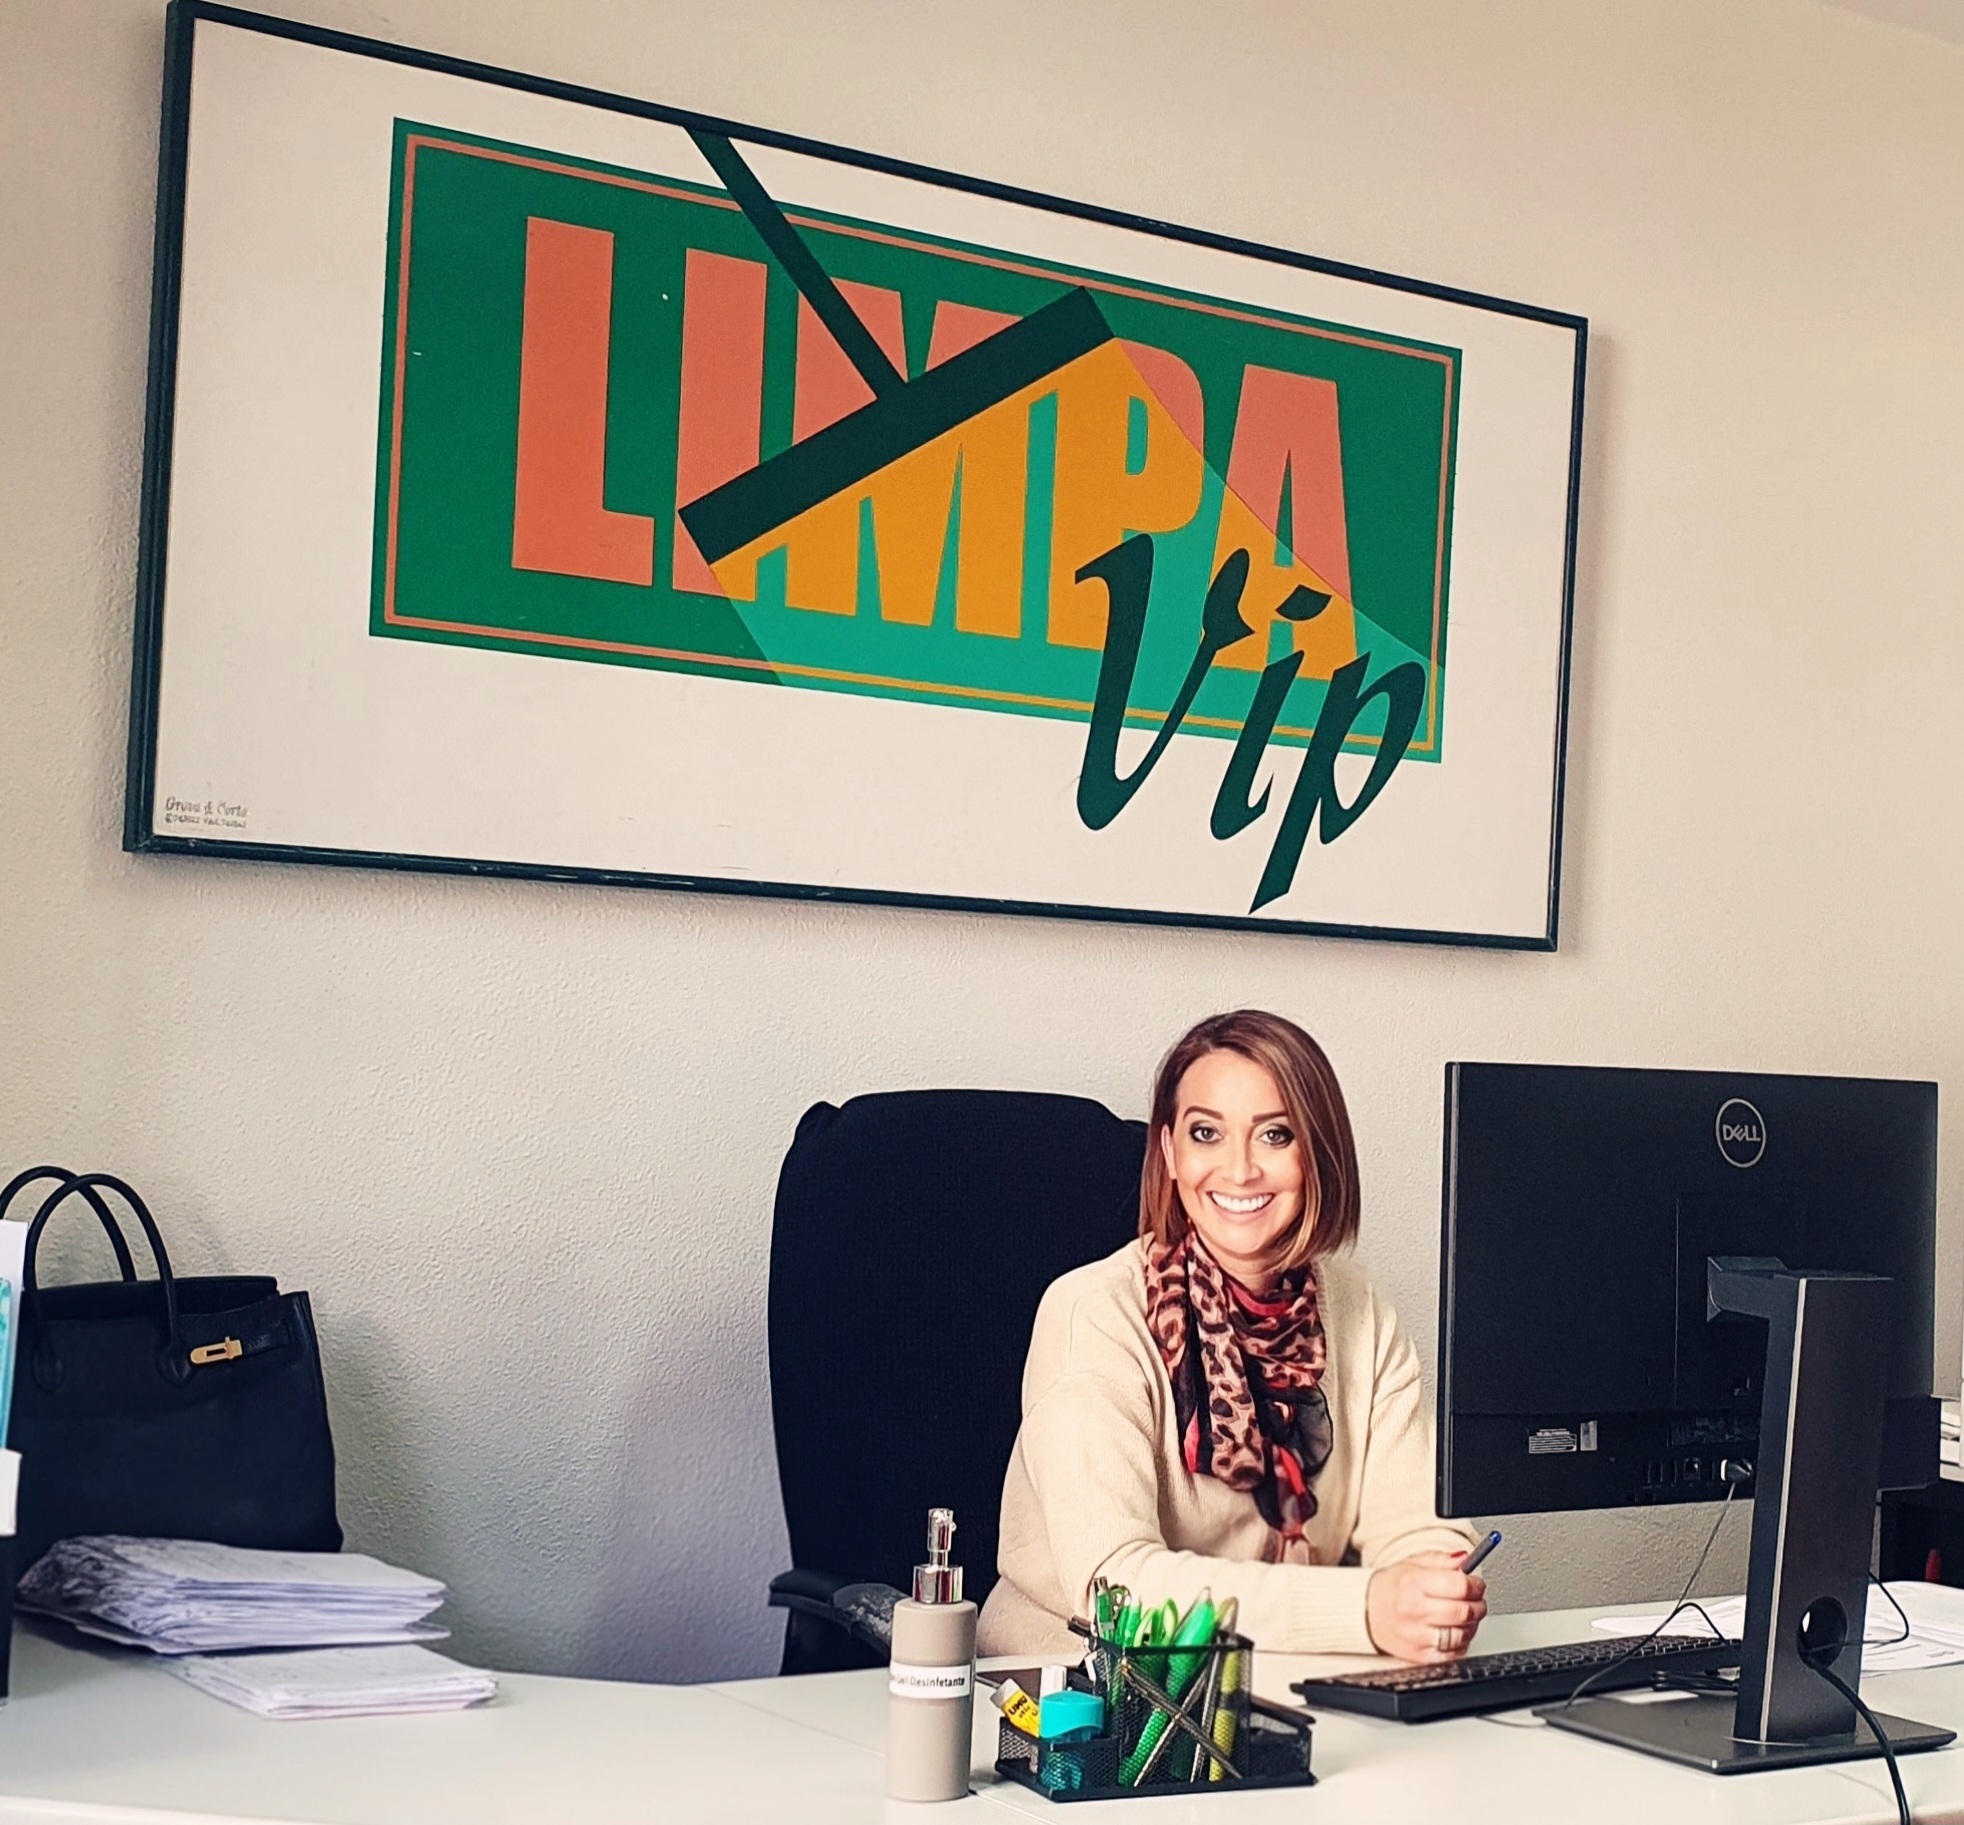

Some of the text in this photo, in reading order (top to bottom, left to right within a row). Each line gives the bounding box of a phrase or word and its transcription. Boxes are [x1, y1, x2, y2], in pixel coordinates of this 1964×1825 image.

[511, 216, 1356, 681] LIMPA
[1074, 533, 1426, 914] Vip
[1722, 1124, 1761, 1142] DELL
[910, 1675, 966, 1687] Desinfetante
